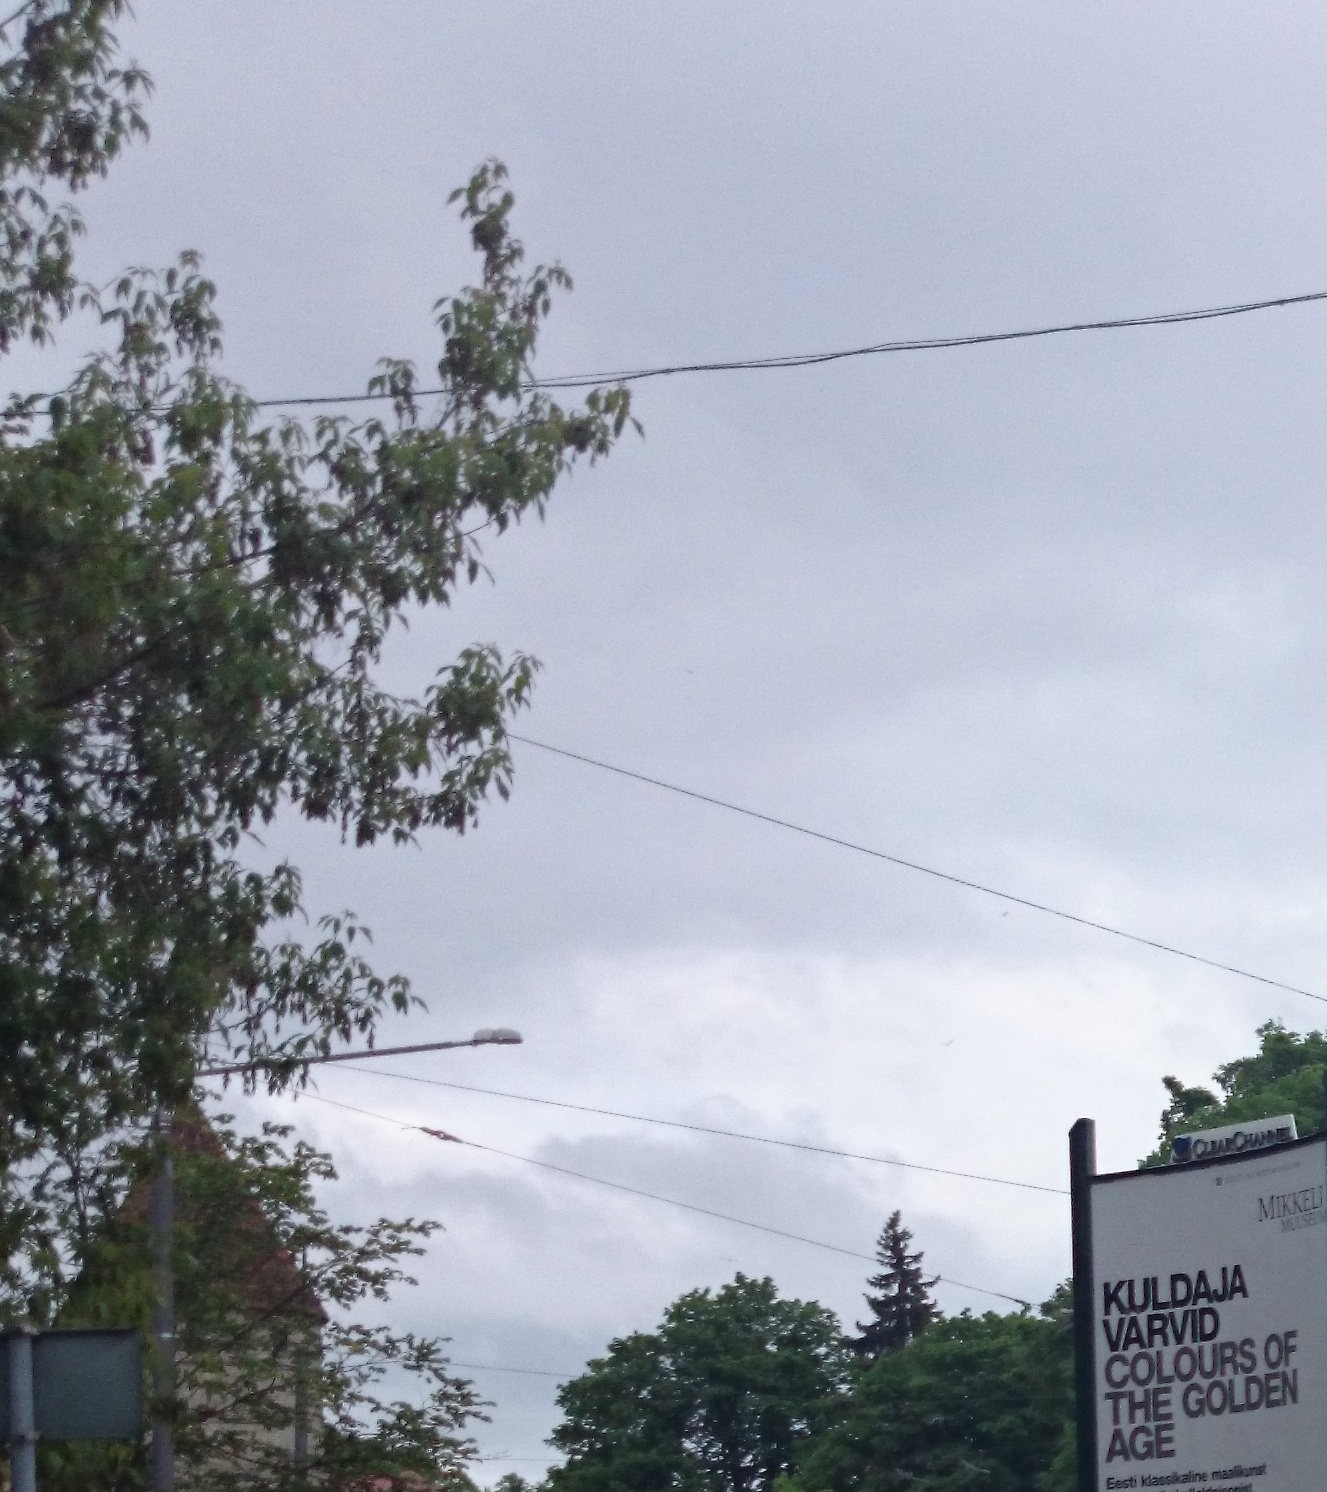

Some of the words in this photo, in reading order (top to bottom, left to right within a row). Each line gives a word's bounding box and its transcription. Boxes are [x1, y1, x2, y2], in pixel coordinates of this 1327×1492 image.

[1258, 1186, 1324, 1221] MIKKELI
[1103, 1264, 1249, 1316] KULDAJA
[1103, 1306, 1220, 1352] VARVID
[1105, 1337, 1257, 1389] COLOURS
[1264, 1330, 1298, 1370] OF
[1105, 1386, 1173, 1425] THE
[1182, 1369, 1299, 1418] GOLDEN
[1106, 1422, 1176, 1463] AGE
[1106, 1476, 1137, 1490] Eesti
